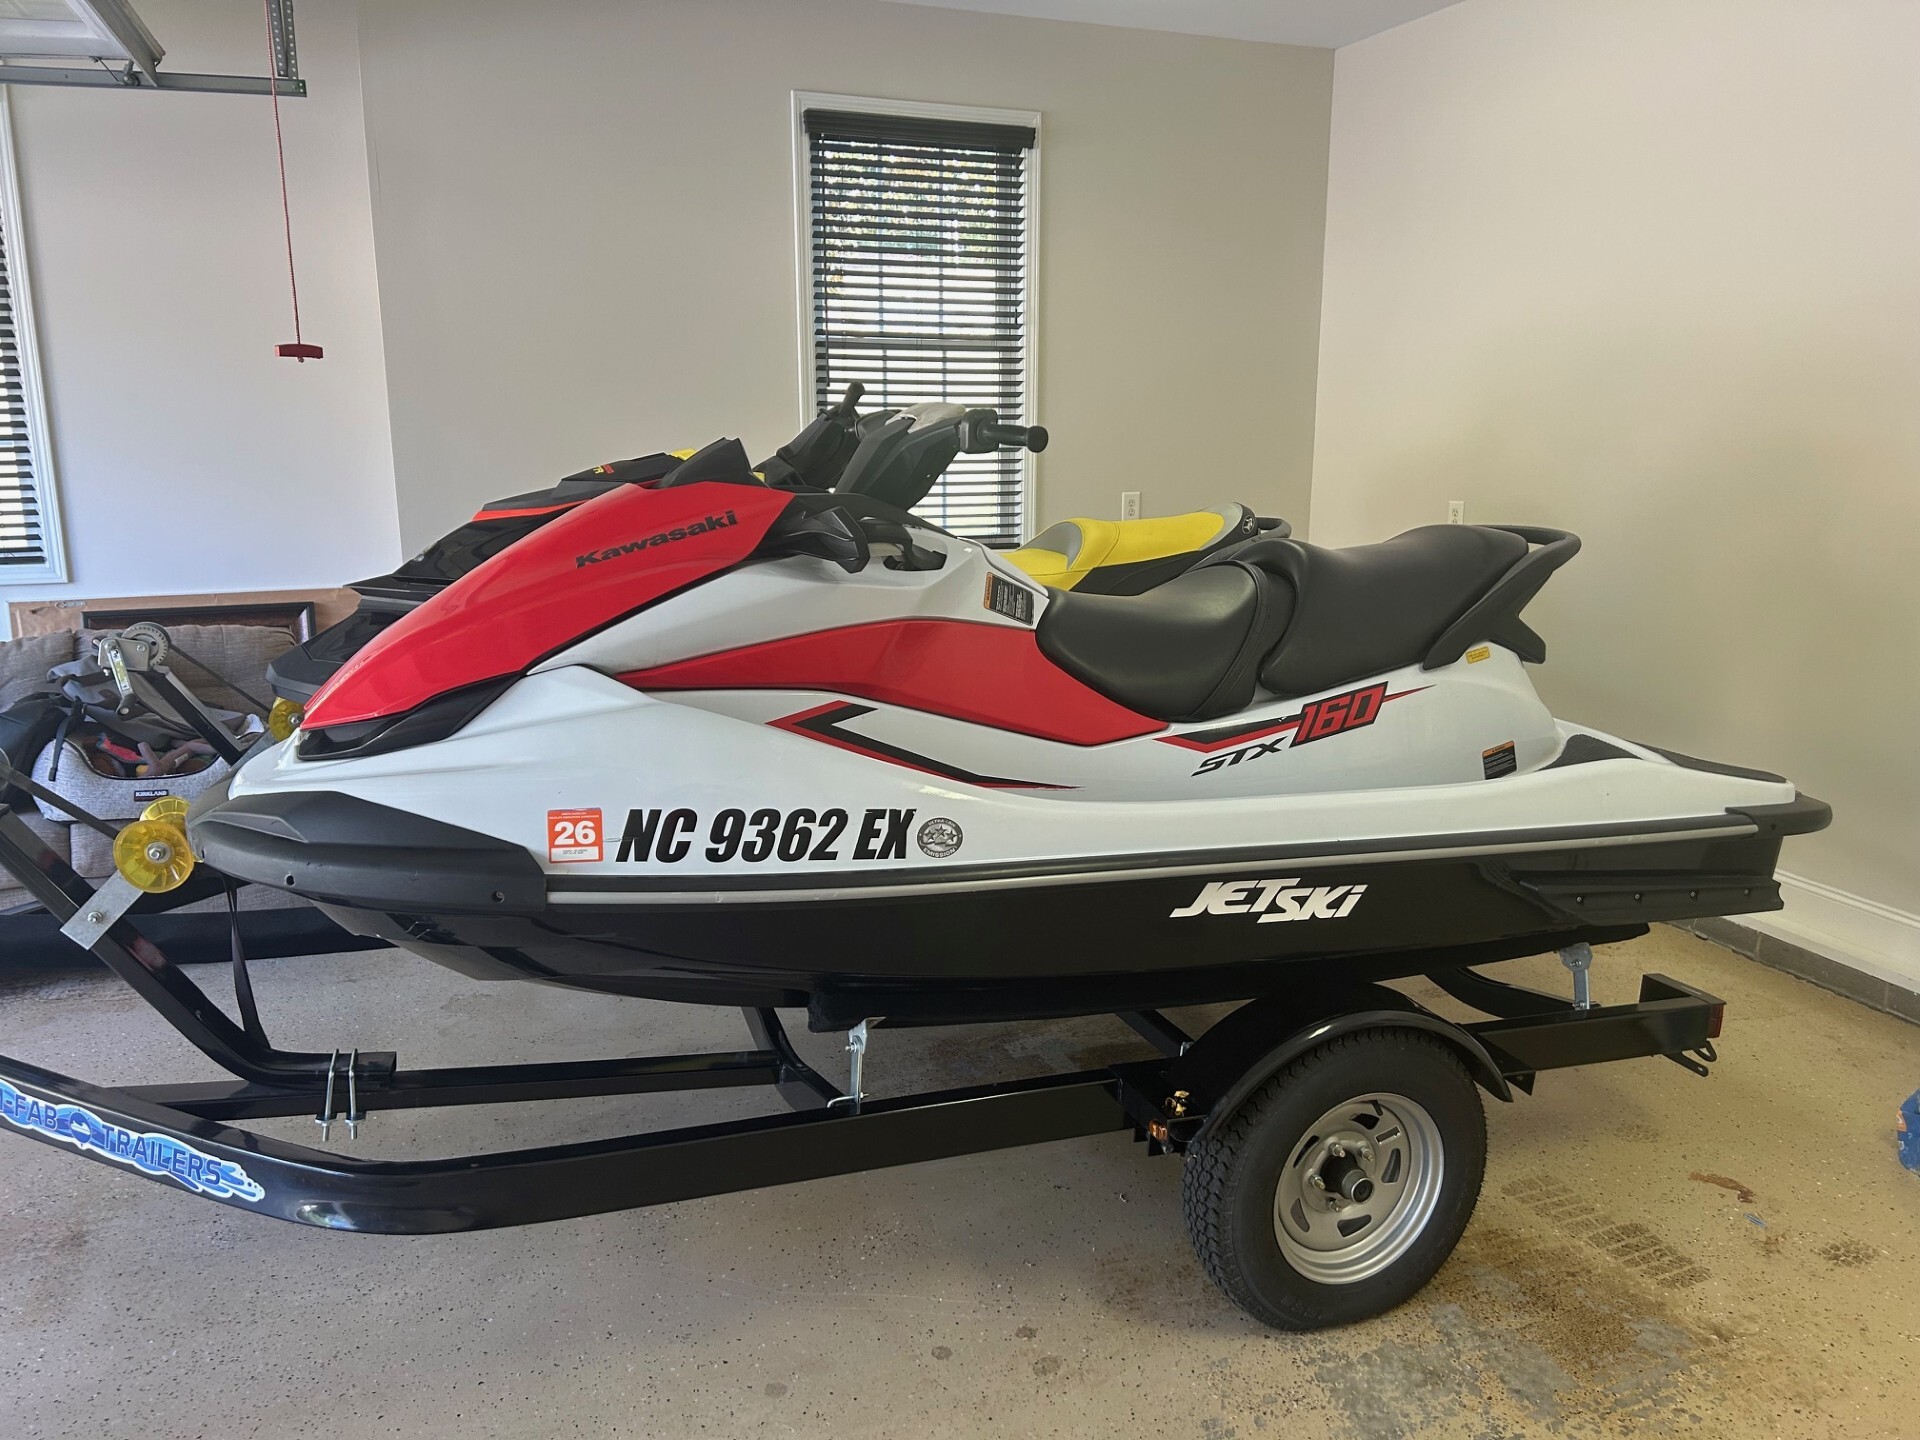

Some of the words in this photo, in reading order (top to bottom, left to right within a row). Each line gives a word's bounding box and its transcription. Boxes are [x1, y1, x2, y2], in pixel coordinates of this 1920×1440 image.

[575, 510, 738, 568] Kawasaki
[1191, 735, 1288, 777] STX
[1294, 685, 1385, 744] 160
[554, 820, 596, 846] 26
[615, 808, 698, 863] NC
[705, 807, 849, 863] 9362
[852, 808, 918, 860] EX
[923, 847, 957, 858] EMISSION
[101, 1123, 222, 1186] TRAILERS
